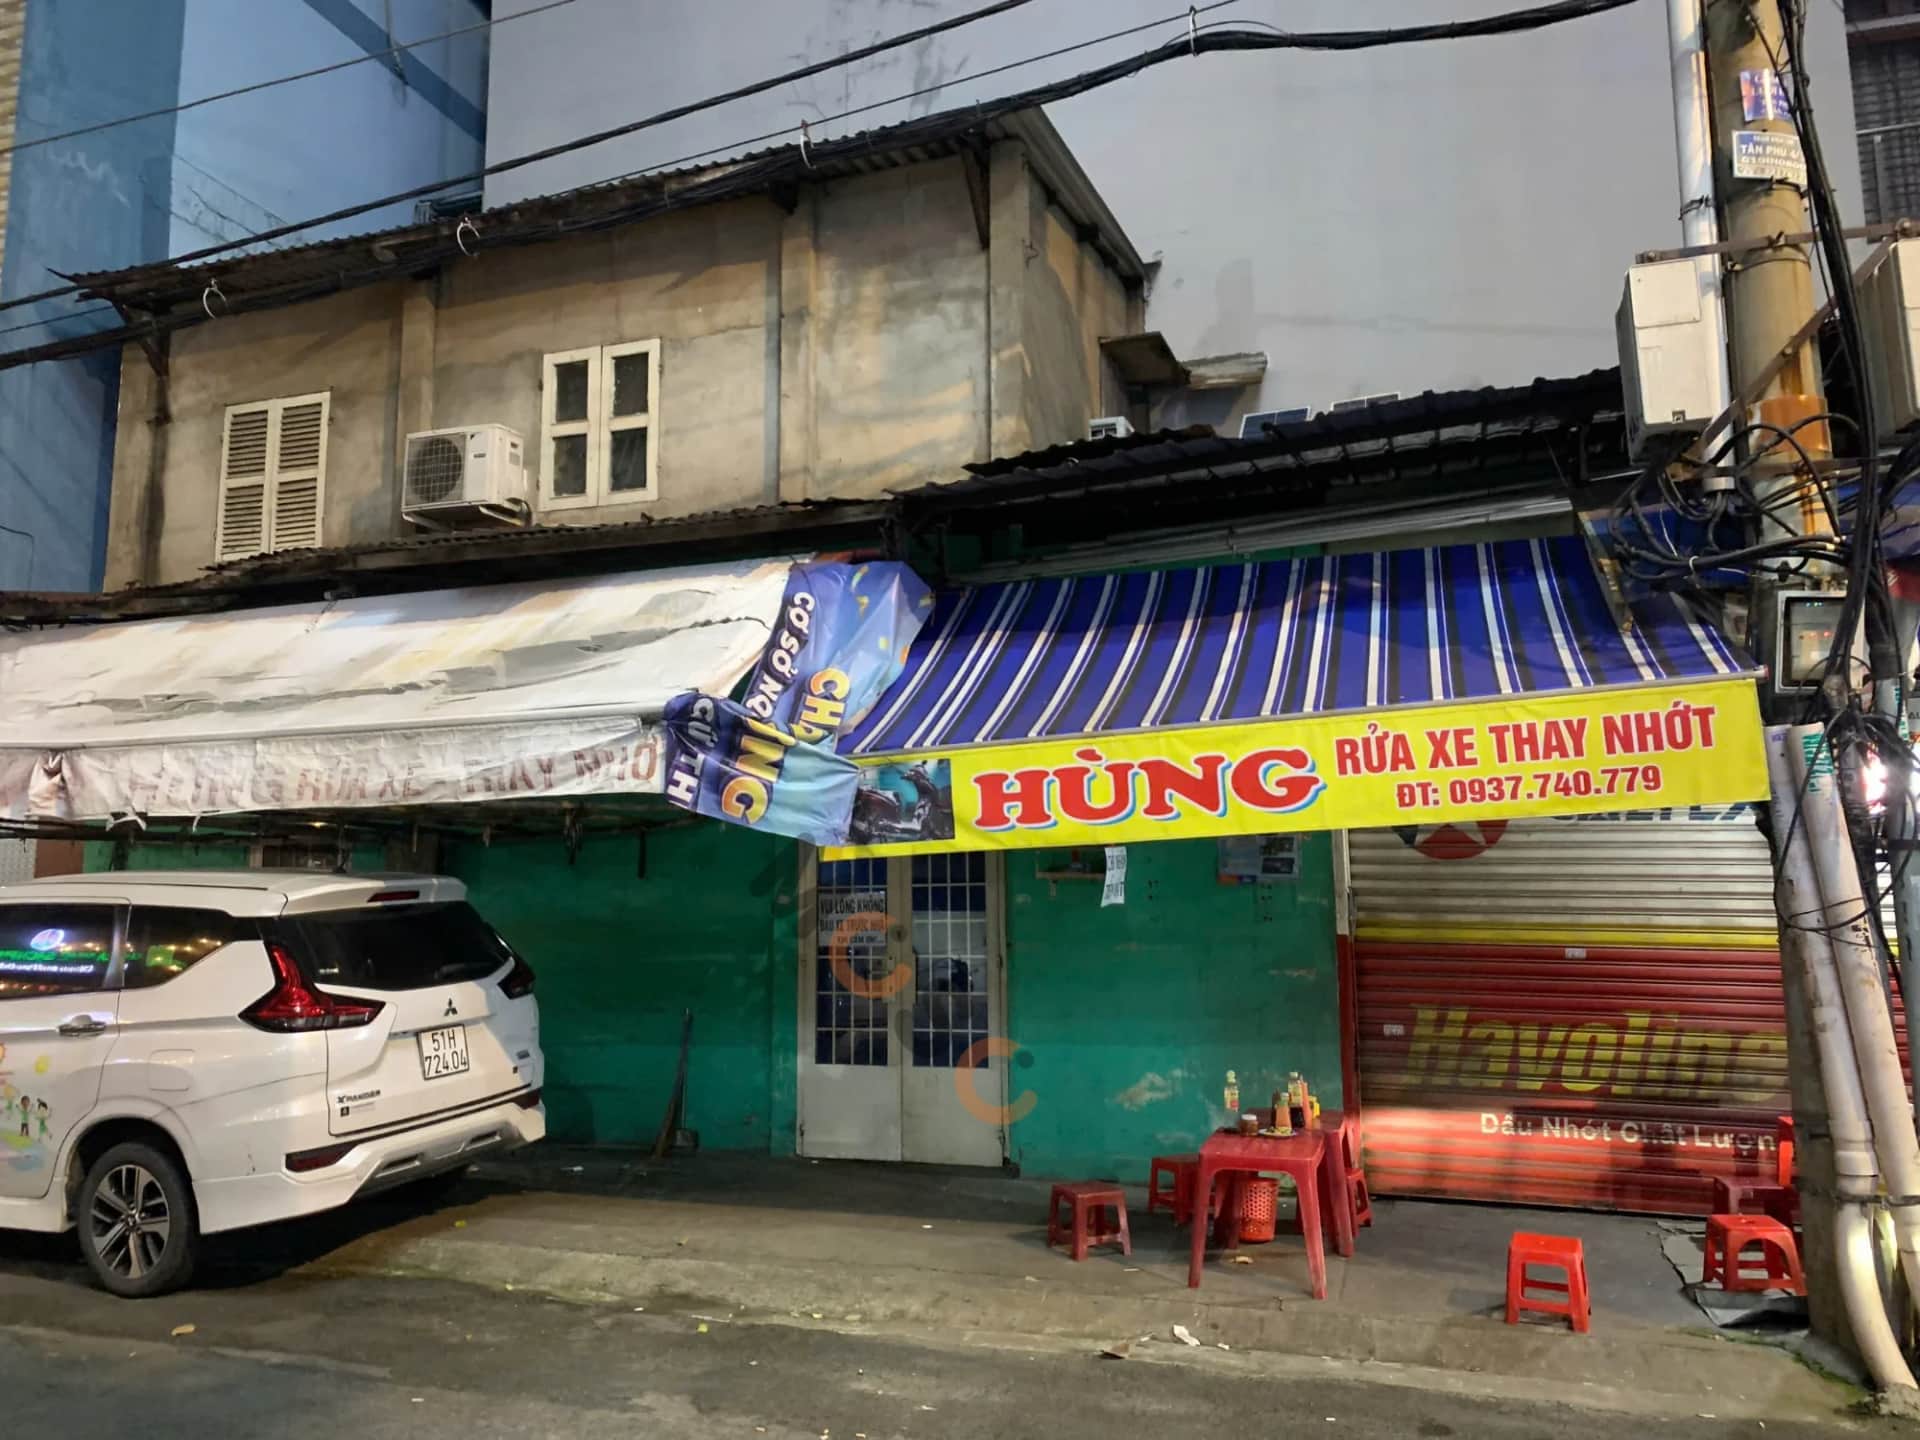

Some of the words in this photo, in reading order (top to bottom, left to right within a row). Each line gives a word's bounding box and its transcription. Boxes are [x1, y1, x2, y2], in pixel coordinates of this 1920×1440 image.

[1335, 721, 1416, 777] RỬA
[1426, 728, 1478, 770] XE
[1487, 717, 1588, 764] THAY
[1602, 700, 1716, 757] NHỚT
[972, 747, 1325, 830] HÙNG
[1396, 783, 1440, 808] ĐT:
[1449, 764, 1662, 805] 0937.740.779
[424, 1049, 468, 1077] 724.04
[432, 1030, 457, 1052] 51H
